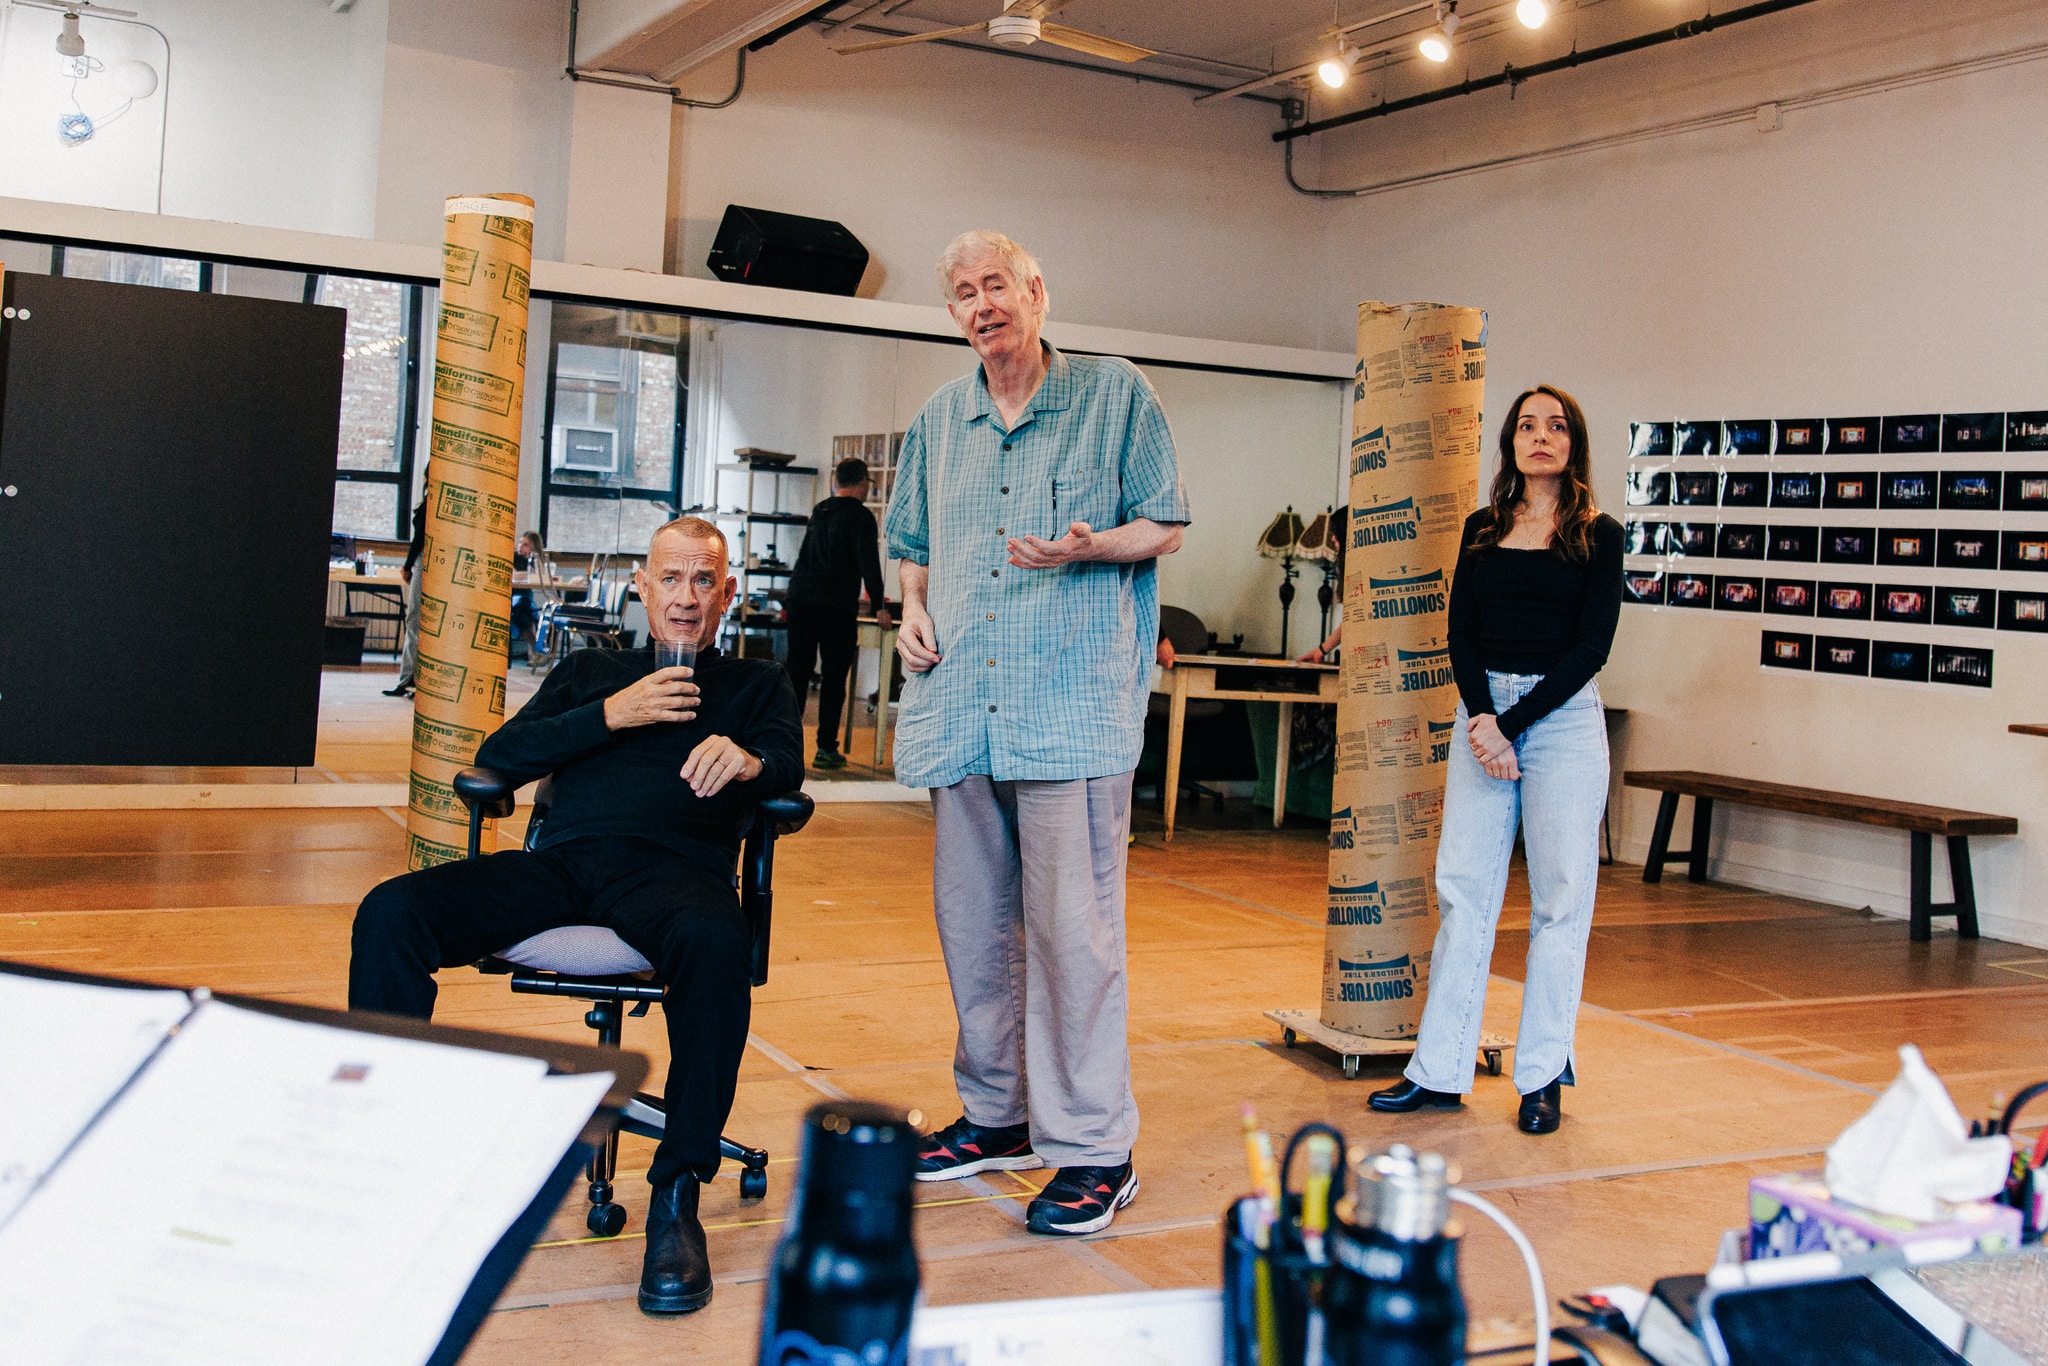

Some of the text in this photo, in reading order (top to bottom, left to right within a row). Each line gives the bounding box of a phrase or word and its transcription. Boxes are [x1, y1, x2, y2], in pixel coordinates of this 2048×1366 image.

[434, 424, 503, 450] Handiforms
[1372, 510, 1408, 523] BUILDER'S
[1375, 582, 1438, 596] BUILDER'S TUBE
[1372, 593, 1445, 619] SONOTUBE
[1405, 661, 1427, 669] TUBE
[1401, 666, 1453, 691] NOTUBE
[1364, 968, 1405, 978] BUILDER'S
[1340, 978, 1414, 1003] SONOTUBE
